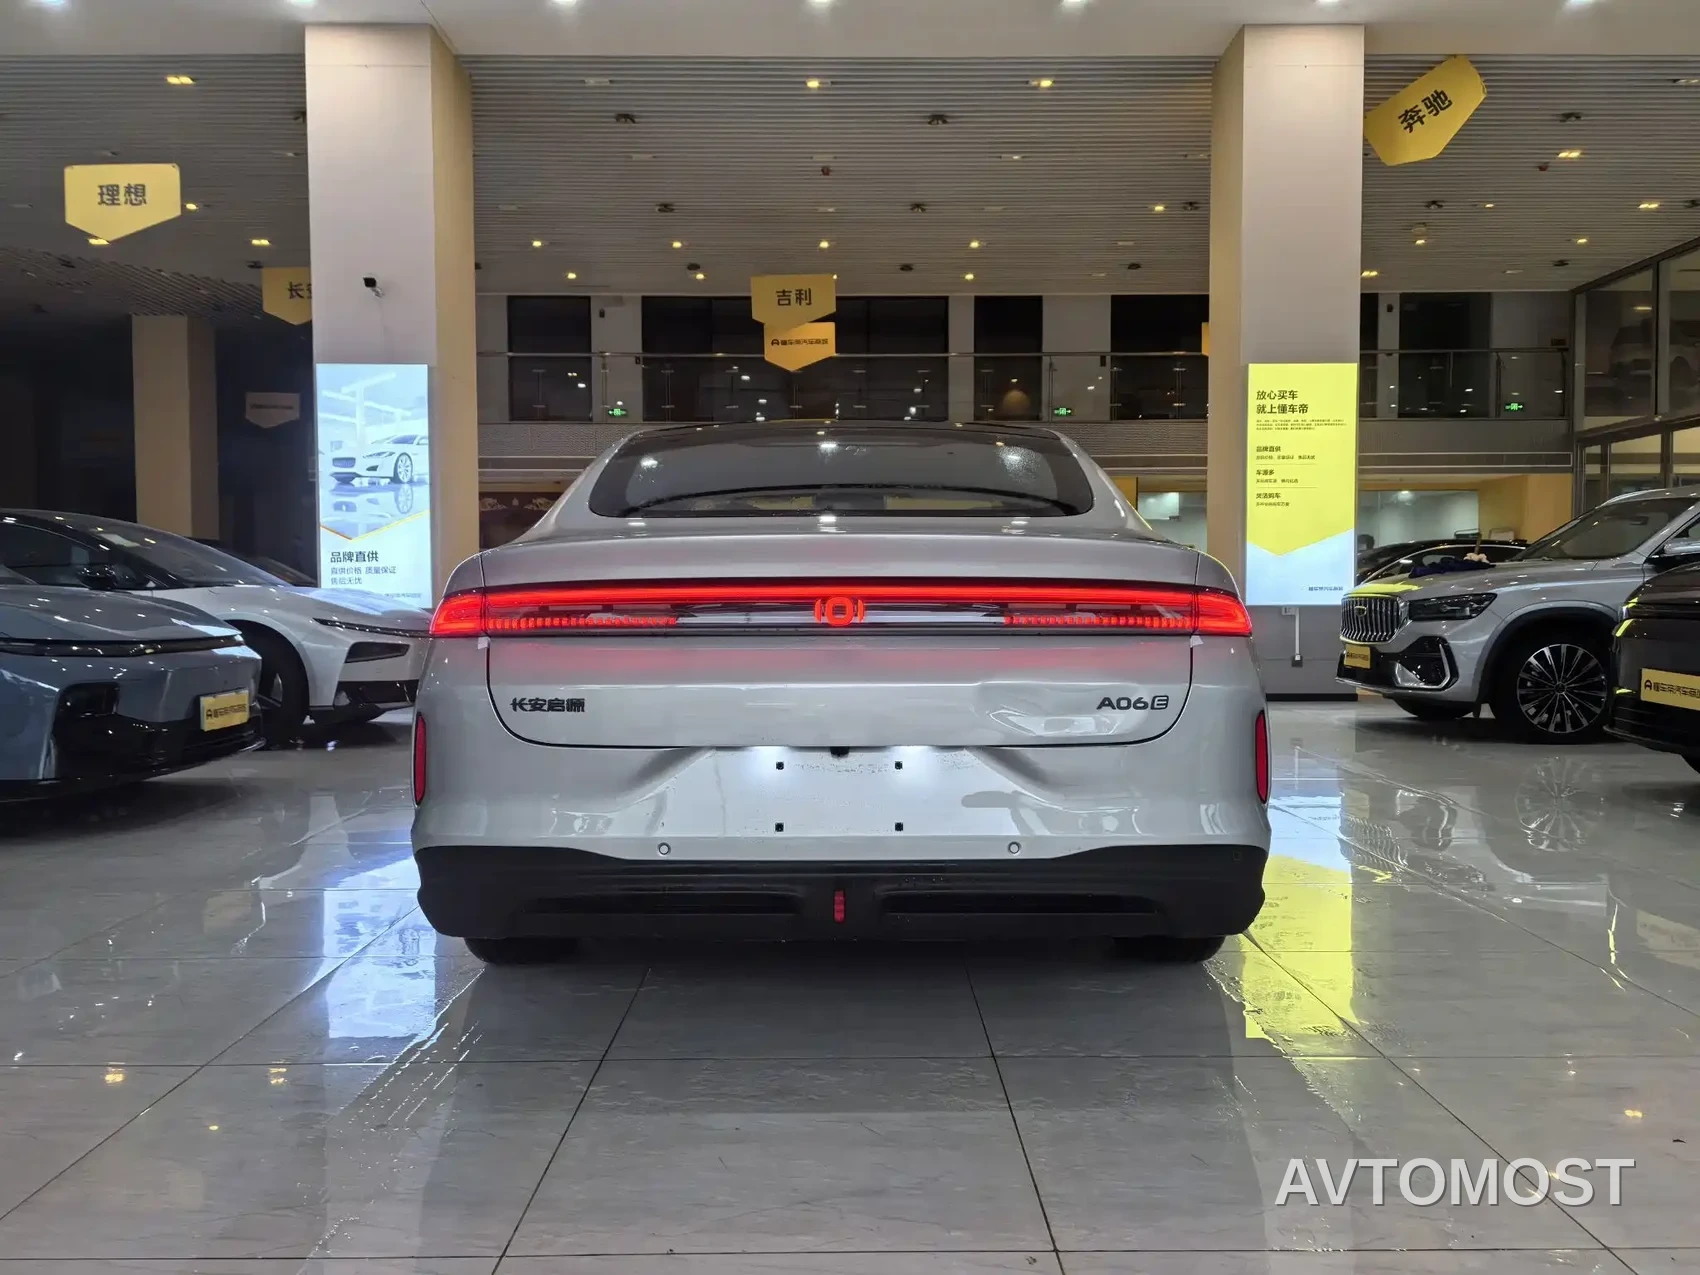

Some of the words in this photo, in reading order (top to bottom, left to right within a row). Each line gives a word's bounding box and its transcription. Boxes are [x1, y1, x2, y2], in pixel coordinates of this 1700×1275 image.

[1398, 89, 1453, 133] 奔驰
[97, 183, 147, 206] 理想
[775, 288, 812, 306] 吉利
[1256, 390, 1298, 400] 放心买车
[1256, 403, 1309, 414] 就上懂车帝
[330, 550, 379, 563] 品牌直供
[510, 697, 585, 712] 长安启源
